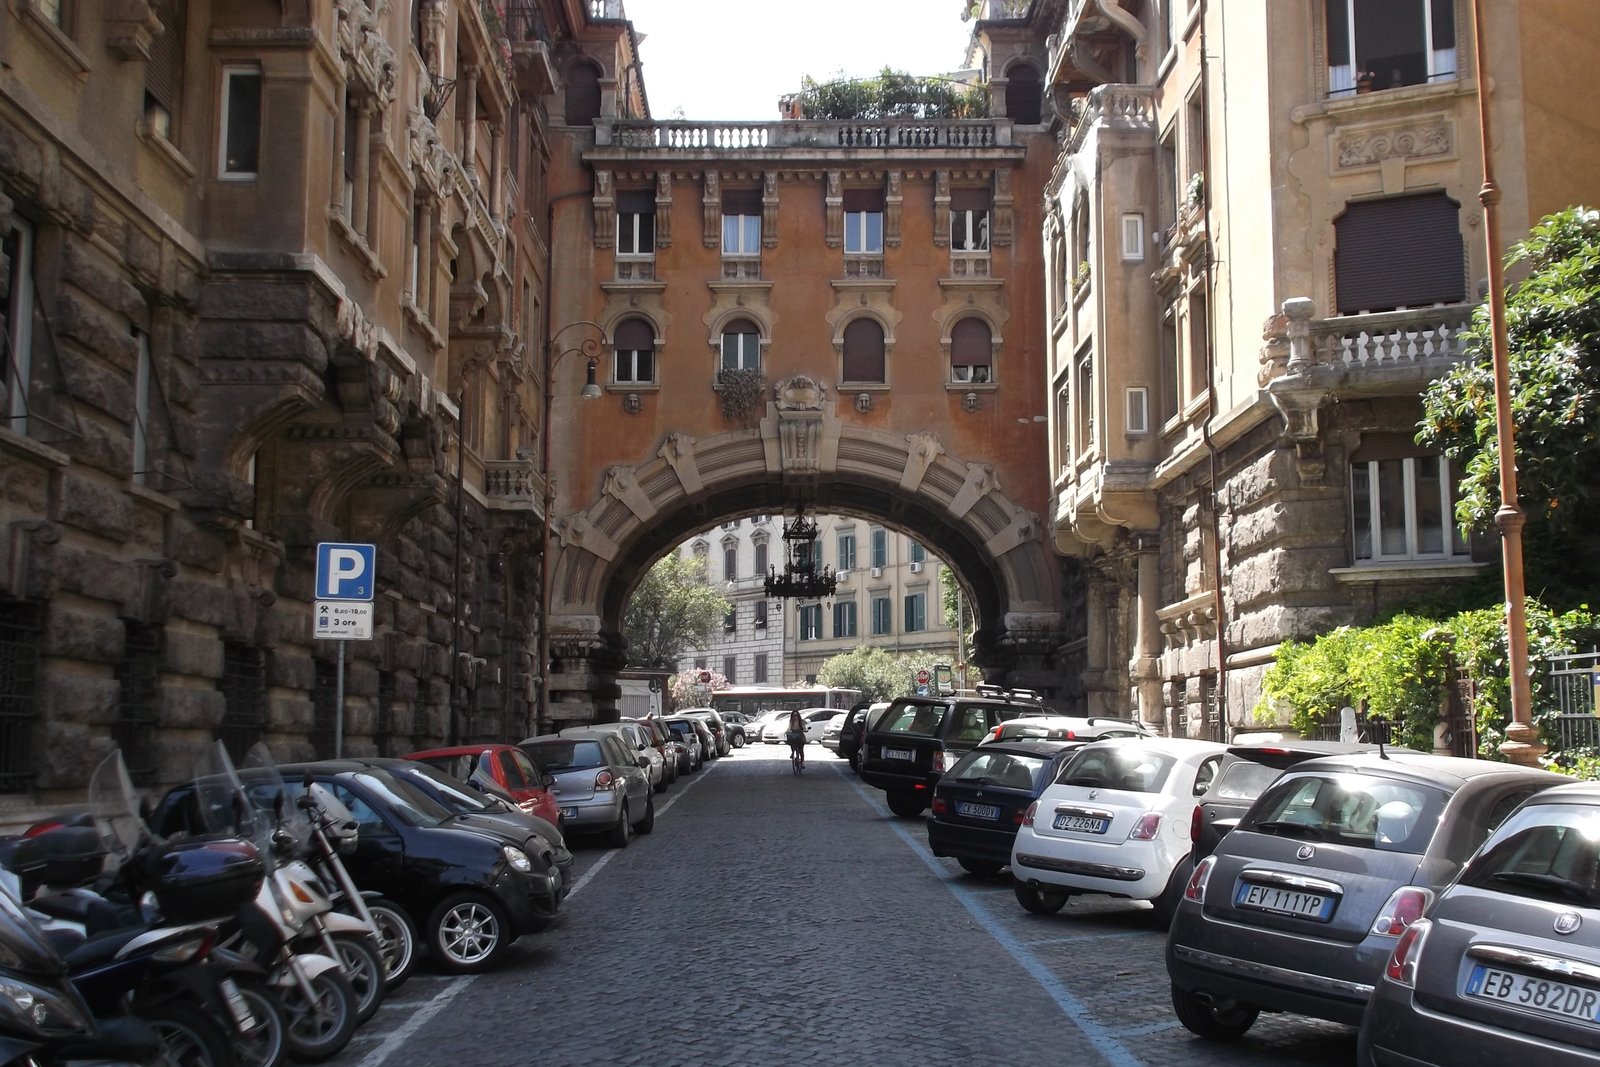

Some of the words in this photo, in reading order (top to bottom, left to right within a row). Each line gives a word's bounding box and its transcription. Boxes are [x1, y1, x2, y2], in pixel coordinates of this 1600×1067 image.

[328, 548, 365, 595] P
[358, 586, 365, 595] 3
[334, 618, 340, 626] 3
[1073, 817, 1100, 831] 226NA
[1247, 886, 1270, 905] EV
[1273, 890, 1321, 914] 111YP
[1482, 971, 1515, 999] EB
[1518, 978, 1598, 1019] 582DR
